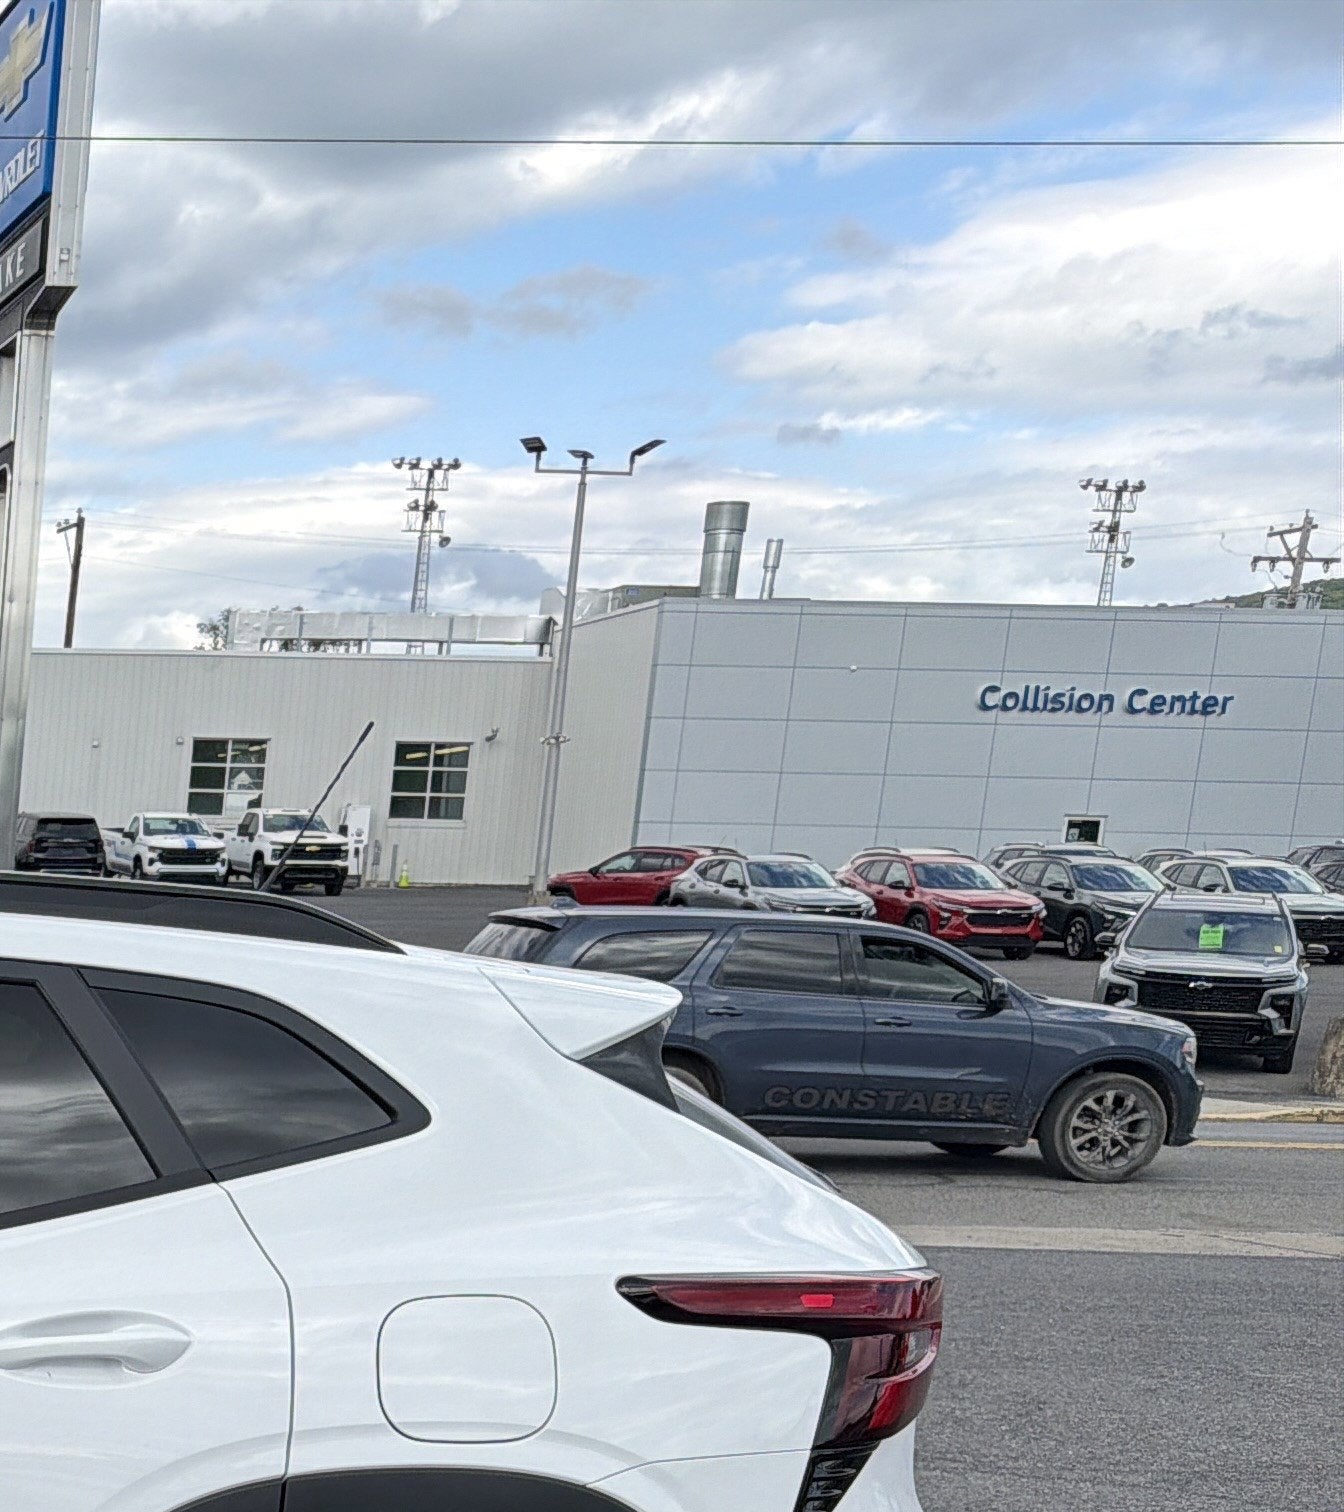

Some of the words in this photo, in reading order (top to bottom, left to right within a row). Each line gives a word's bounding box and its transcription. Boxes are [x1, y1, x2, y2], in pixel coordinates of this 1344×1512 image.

[978, 684, 1115, 713] Collision
[1125, 688, 1235, 716] Center
[763, 1085, 1015, 1118] CONSTABLE
